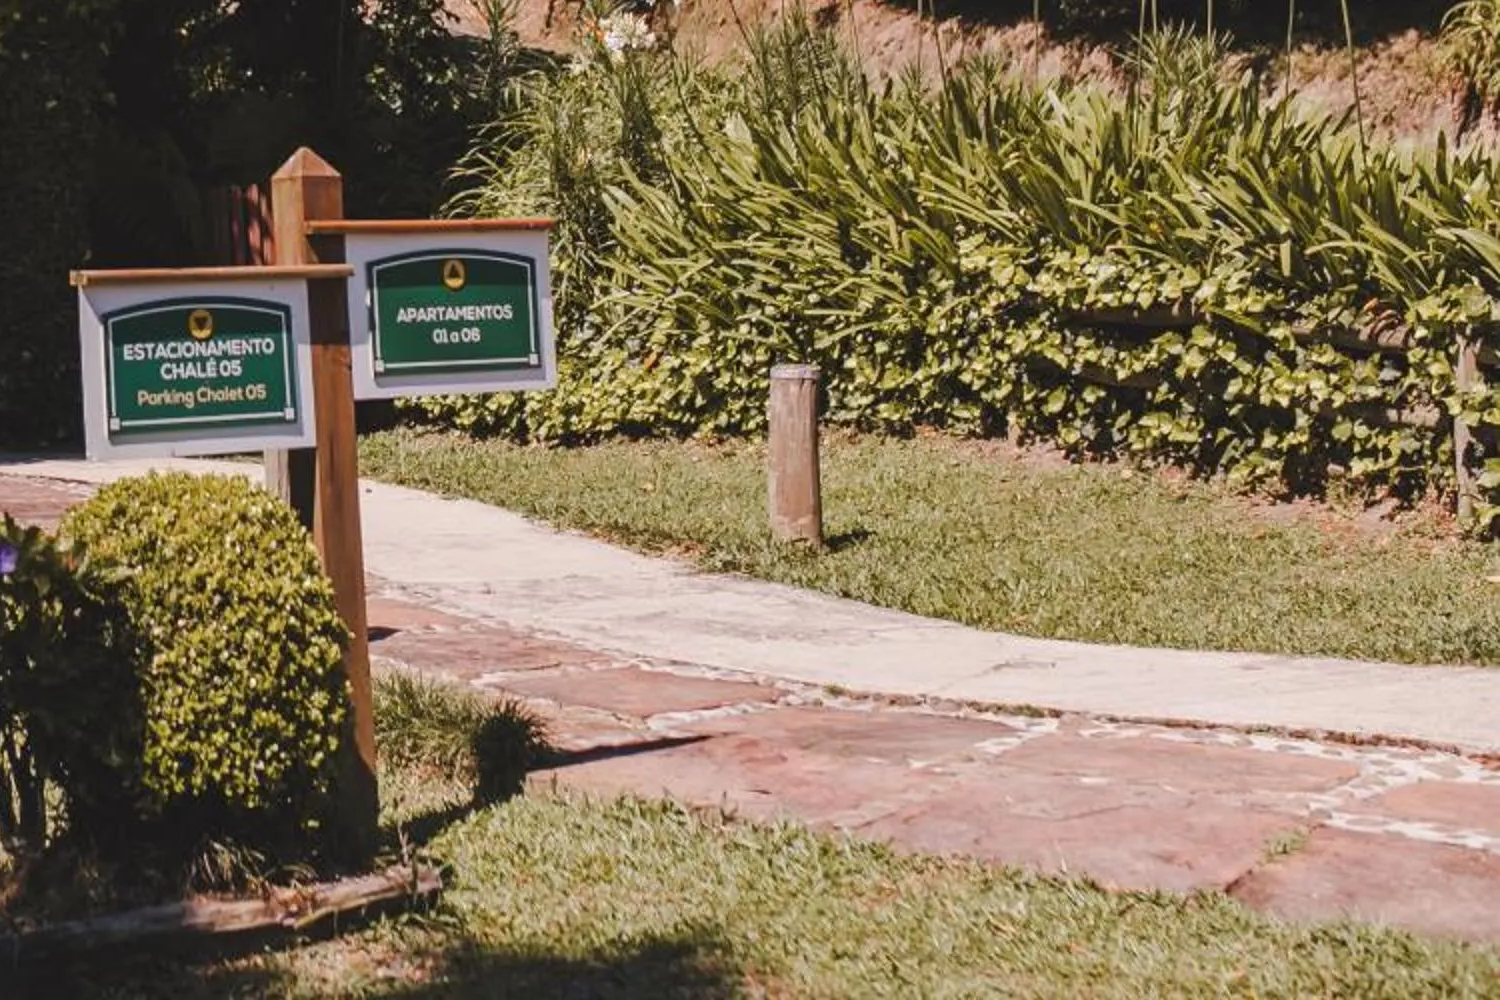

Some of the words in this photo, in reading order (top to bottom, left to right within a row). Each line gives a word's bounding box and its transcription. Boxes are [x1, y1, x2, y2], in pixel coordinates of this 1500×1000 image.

[396, 304, 513, 323] APARTAMENTOS
[433, 328, 449, 344] 01
[123, 338, 275, 361] ESTACIONAMENTO
[160, 358, 217, 380] CHALÉ
[219, 360, 243, 377] 05
[137, 389, 194, 409] Parking
[196, 385, 244, 403] Chalet
[245, 384, 267, 400] 05
